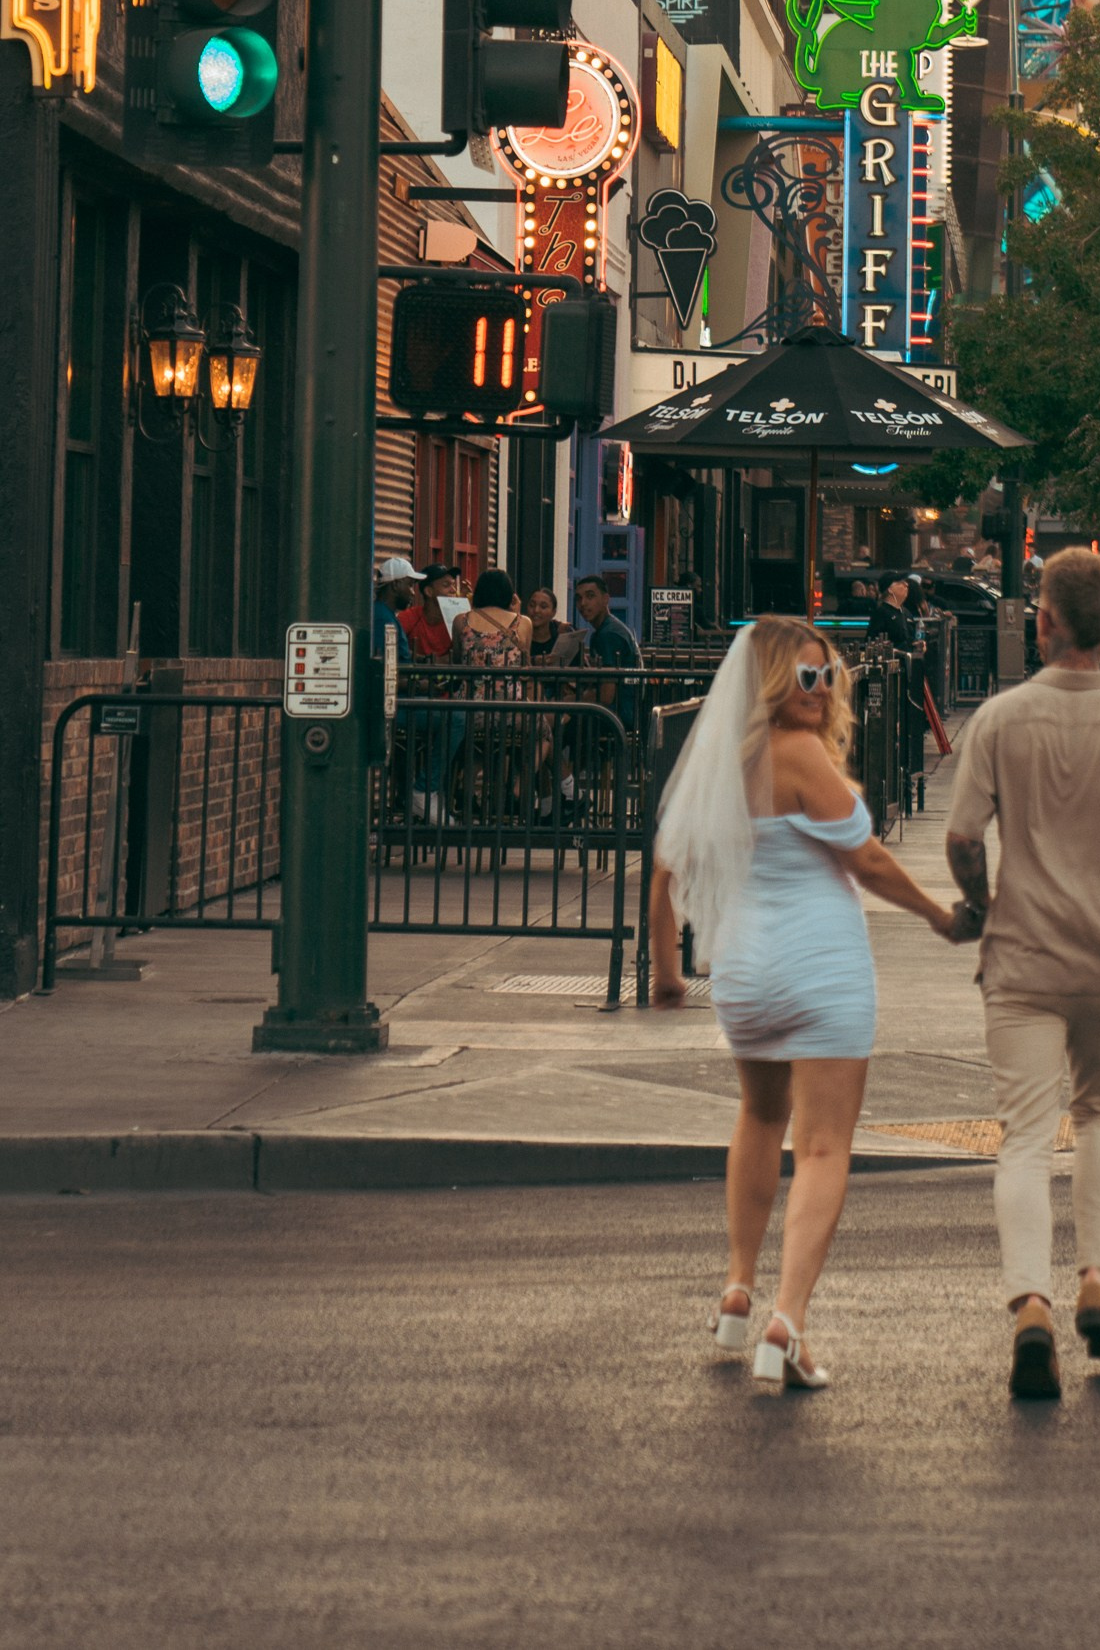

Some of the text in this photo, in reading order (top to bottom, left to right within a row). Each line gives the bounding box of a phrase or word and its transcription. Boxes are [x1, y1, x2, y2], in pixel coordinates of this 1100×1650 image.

[861, 51, 898, 78] THE
[557, 135, 601, 163] LAS VEGAS
[860, 83, 900, 348] GRIFF
[473, 316, 516, 389] 11
[726, 408, 825, 425] TELSÓN
[850, 410, 944, 425] TELSÓN
[886, 425, 932, 439] Tequila
[652, 592, 692, 602] ICE CREAM
